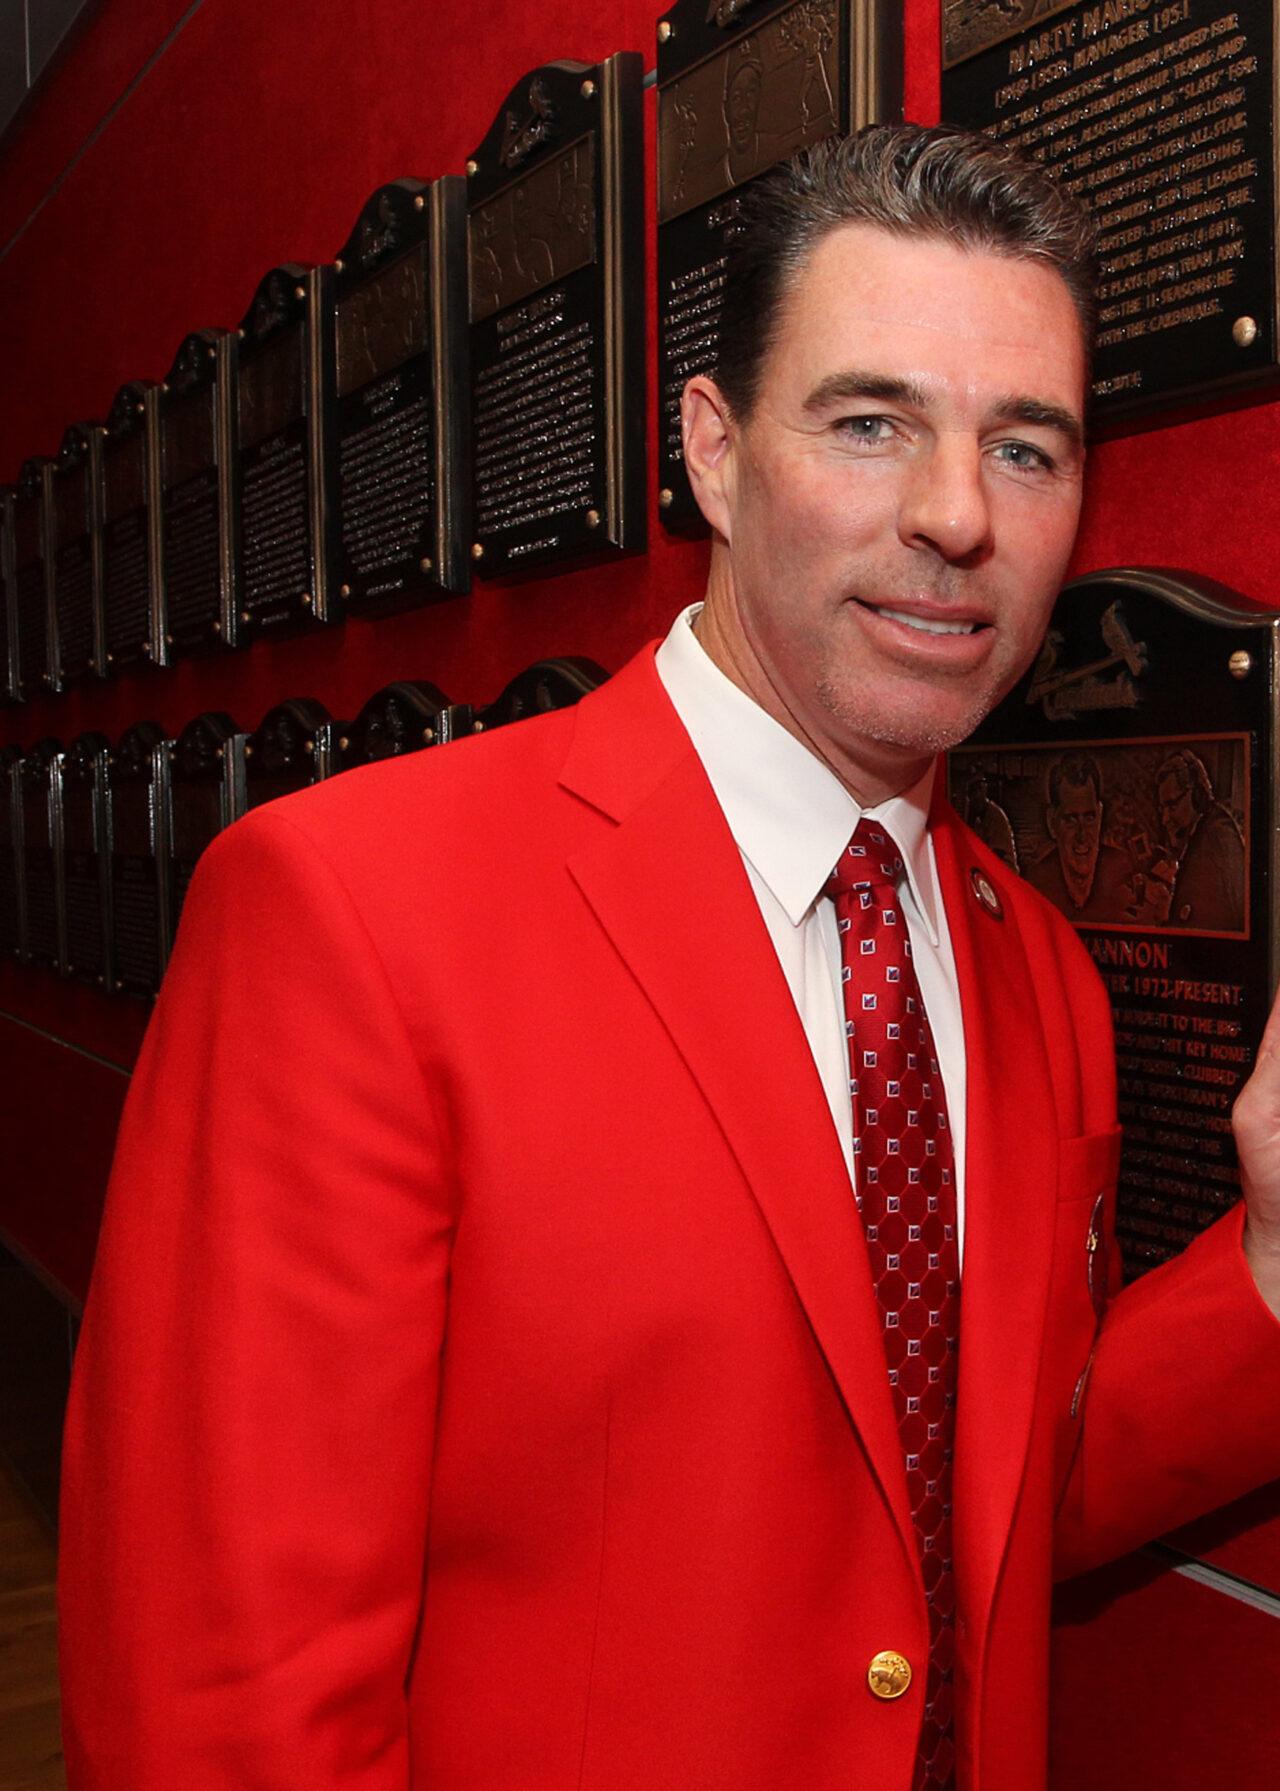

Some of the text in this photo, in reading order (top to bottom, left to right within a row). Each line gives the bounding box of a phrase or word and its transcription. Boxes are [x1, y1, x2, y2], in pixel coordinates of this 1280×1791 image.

[1073, 20, 1149, 71] MANAGER
[1183, 138, 1244, 173] FIELDING
[1207, 158, 1257, 190] LEAGUE
[1135, 977, 1242, 1006] 1972-PRESENT
[1184, 1064, 1236, 1086] CLUBBED
